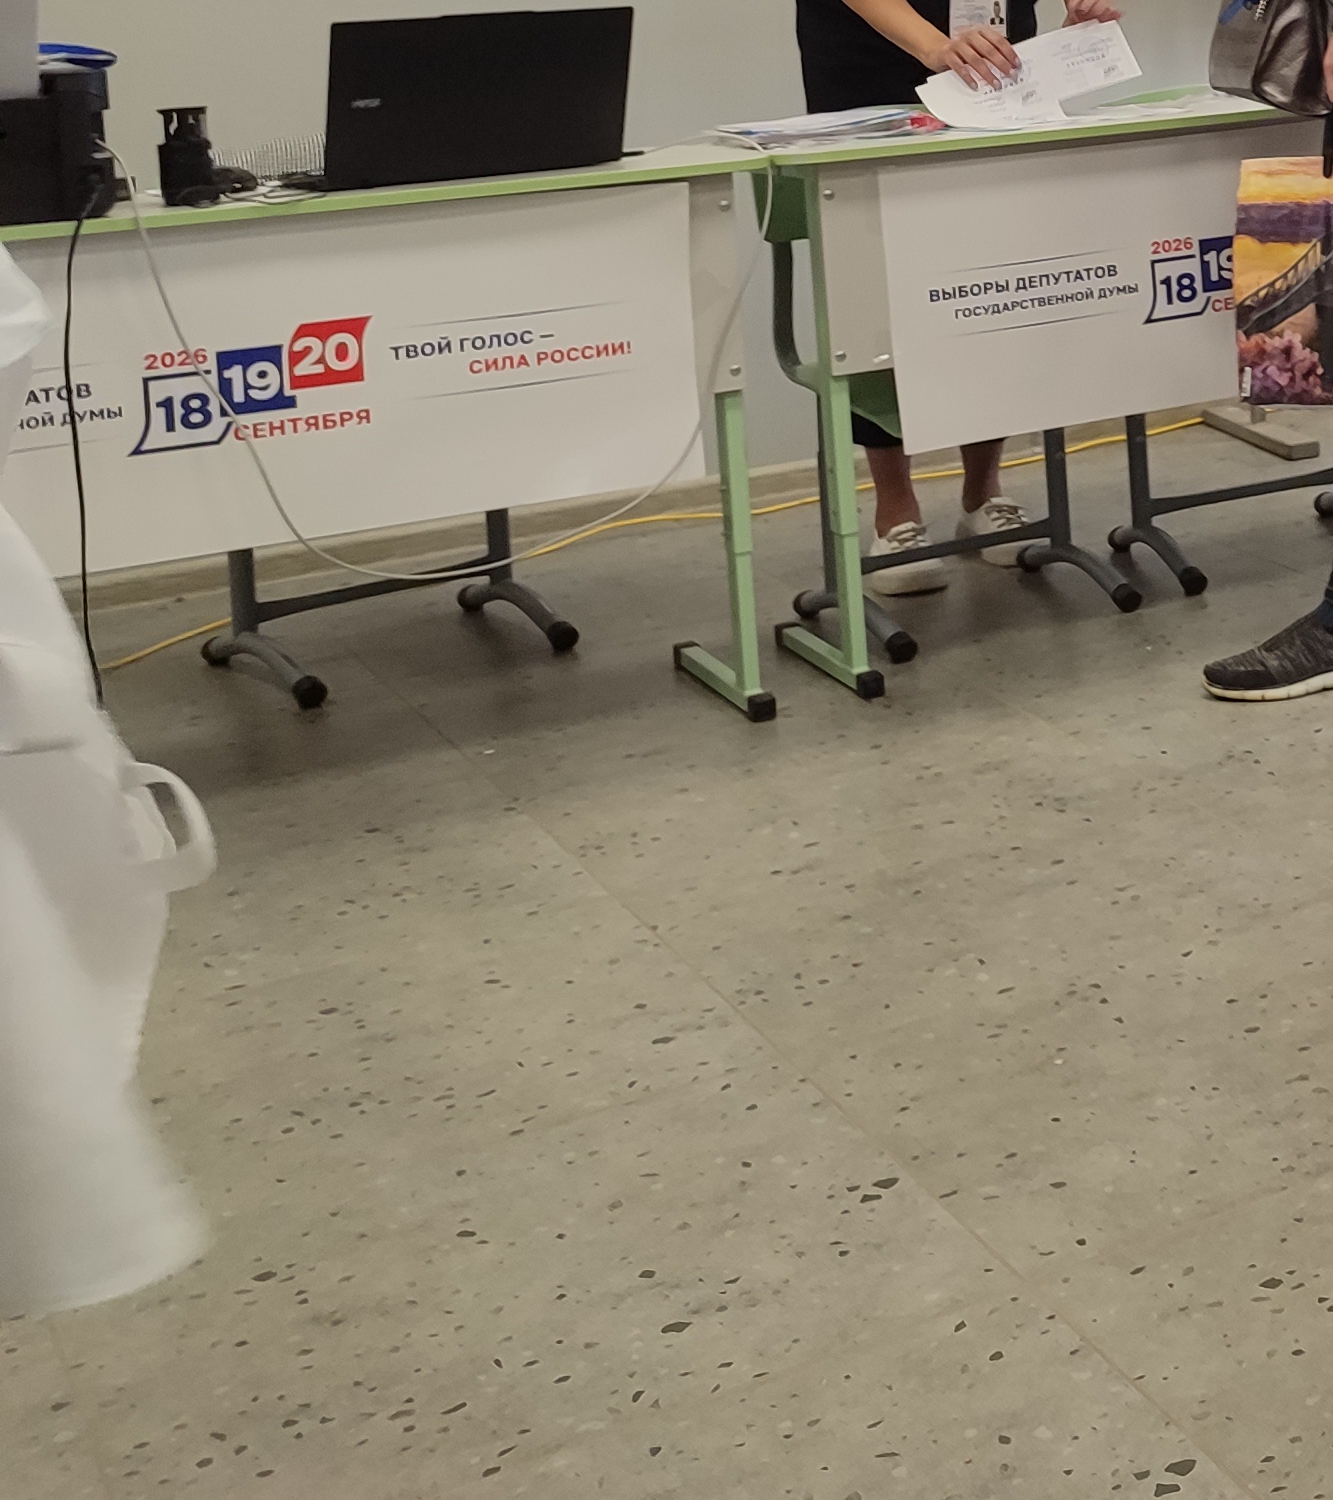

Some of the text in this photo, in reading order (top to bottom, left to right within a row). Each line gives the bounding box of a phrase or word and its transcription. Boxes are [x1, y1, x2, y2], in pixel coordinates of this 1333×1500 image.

[1151, 236, 1193, 254] 2026
[929, 264, 1118, 303] ВЫБОРЫ ДЕПУТАТОВ
[1160, 272, 1197, 305] 18
[954, 283, 1139, 319] ГОСУДАРСТВЕННОЙ ДУМЫ
[142, 348, 208, 371] 2026
[389, 335, 452, 360] ТВОЙ
[459, 329, 534, 353] ГОЛОС
[469, 340, 633, 375] СИЛА РОССИИ!
[155, 332, 360, 433] 18 19 20
[60, 406, 124, 428] ДУМЫ
[233, 408, 371, 442] СЕНТЯБРЯ
